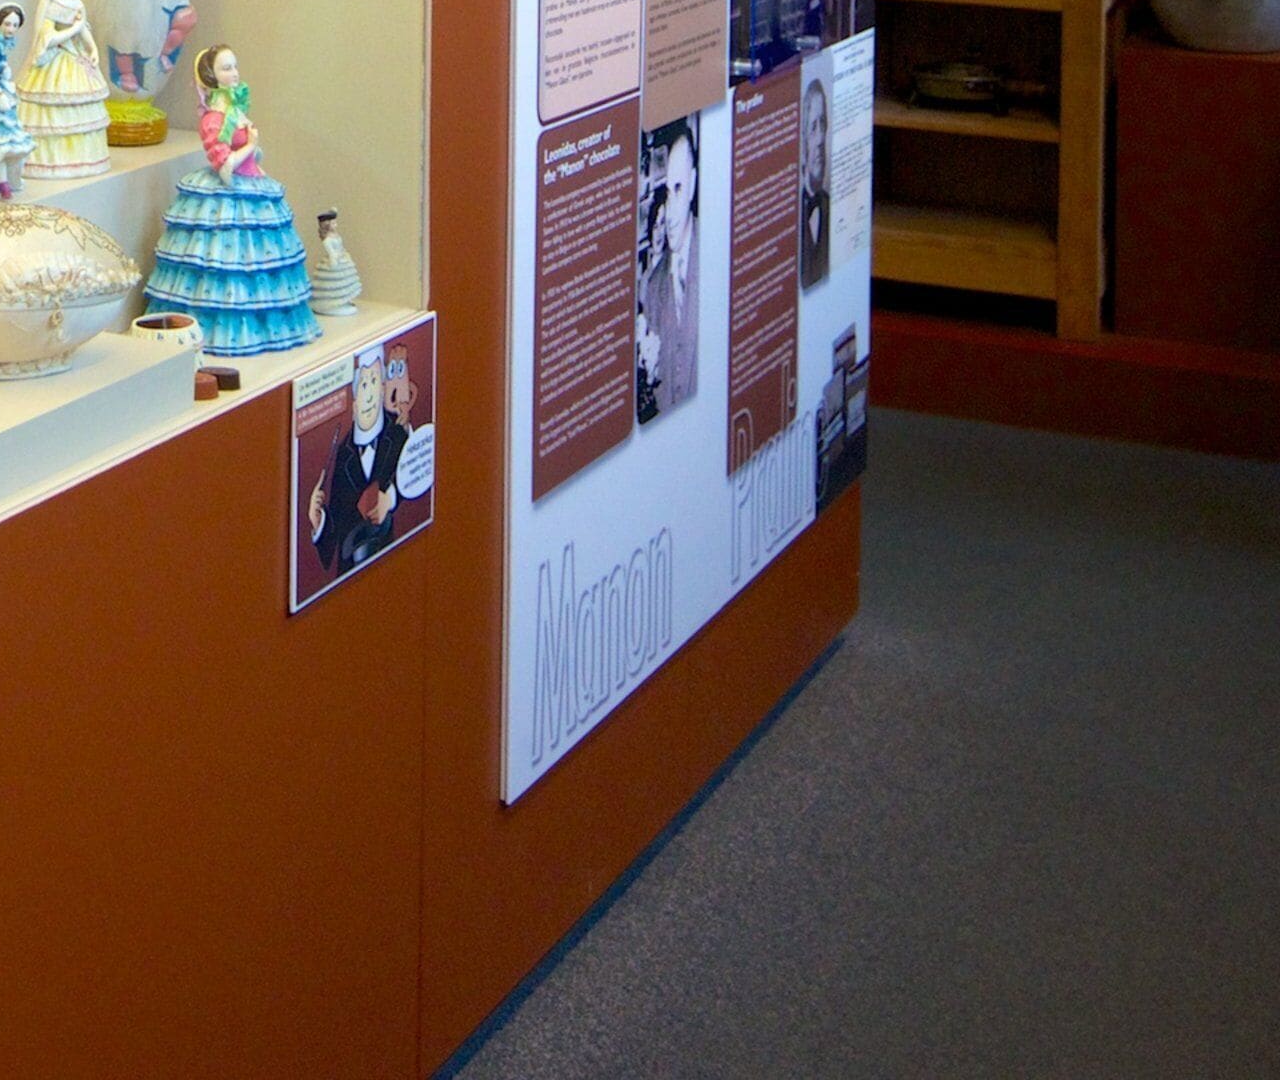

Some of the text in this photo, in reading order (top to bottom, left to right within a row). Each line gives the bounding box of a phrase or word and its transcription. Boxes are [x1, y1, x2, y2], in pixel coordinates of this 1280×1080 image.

[544, 140, 577, 165] Leonidas,
[577, 131, 603, 151] creator
[531, 526, 673, 768] Manon
